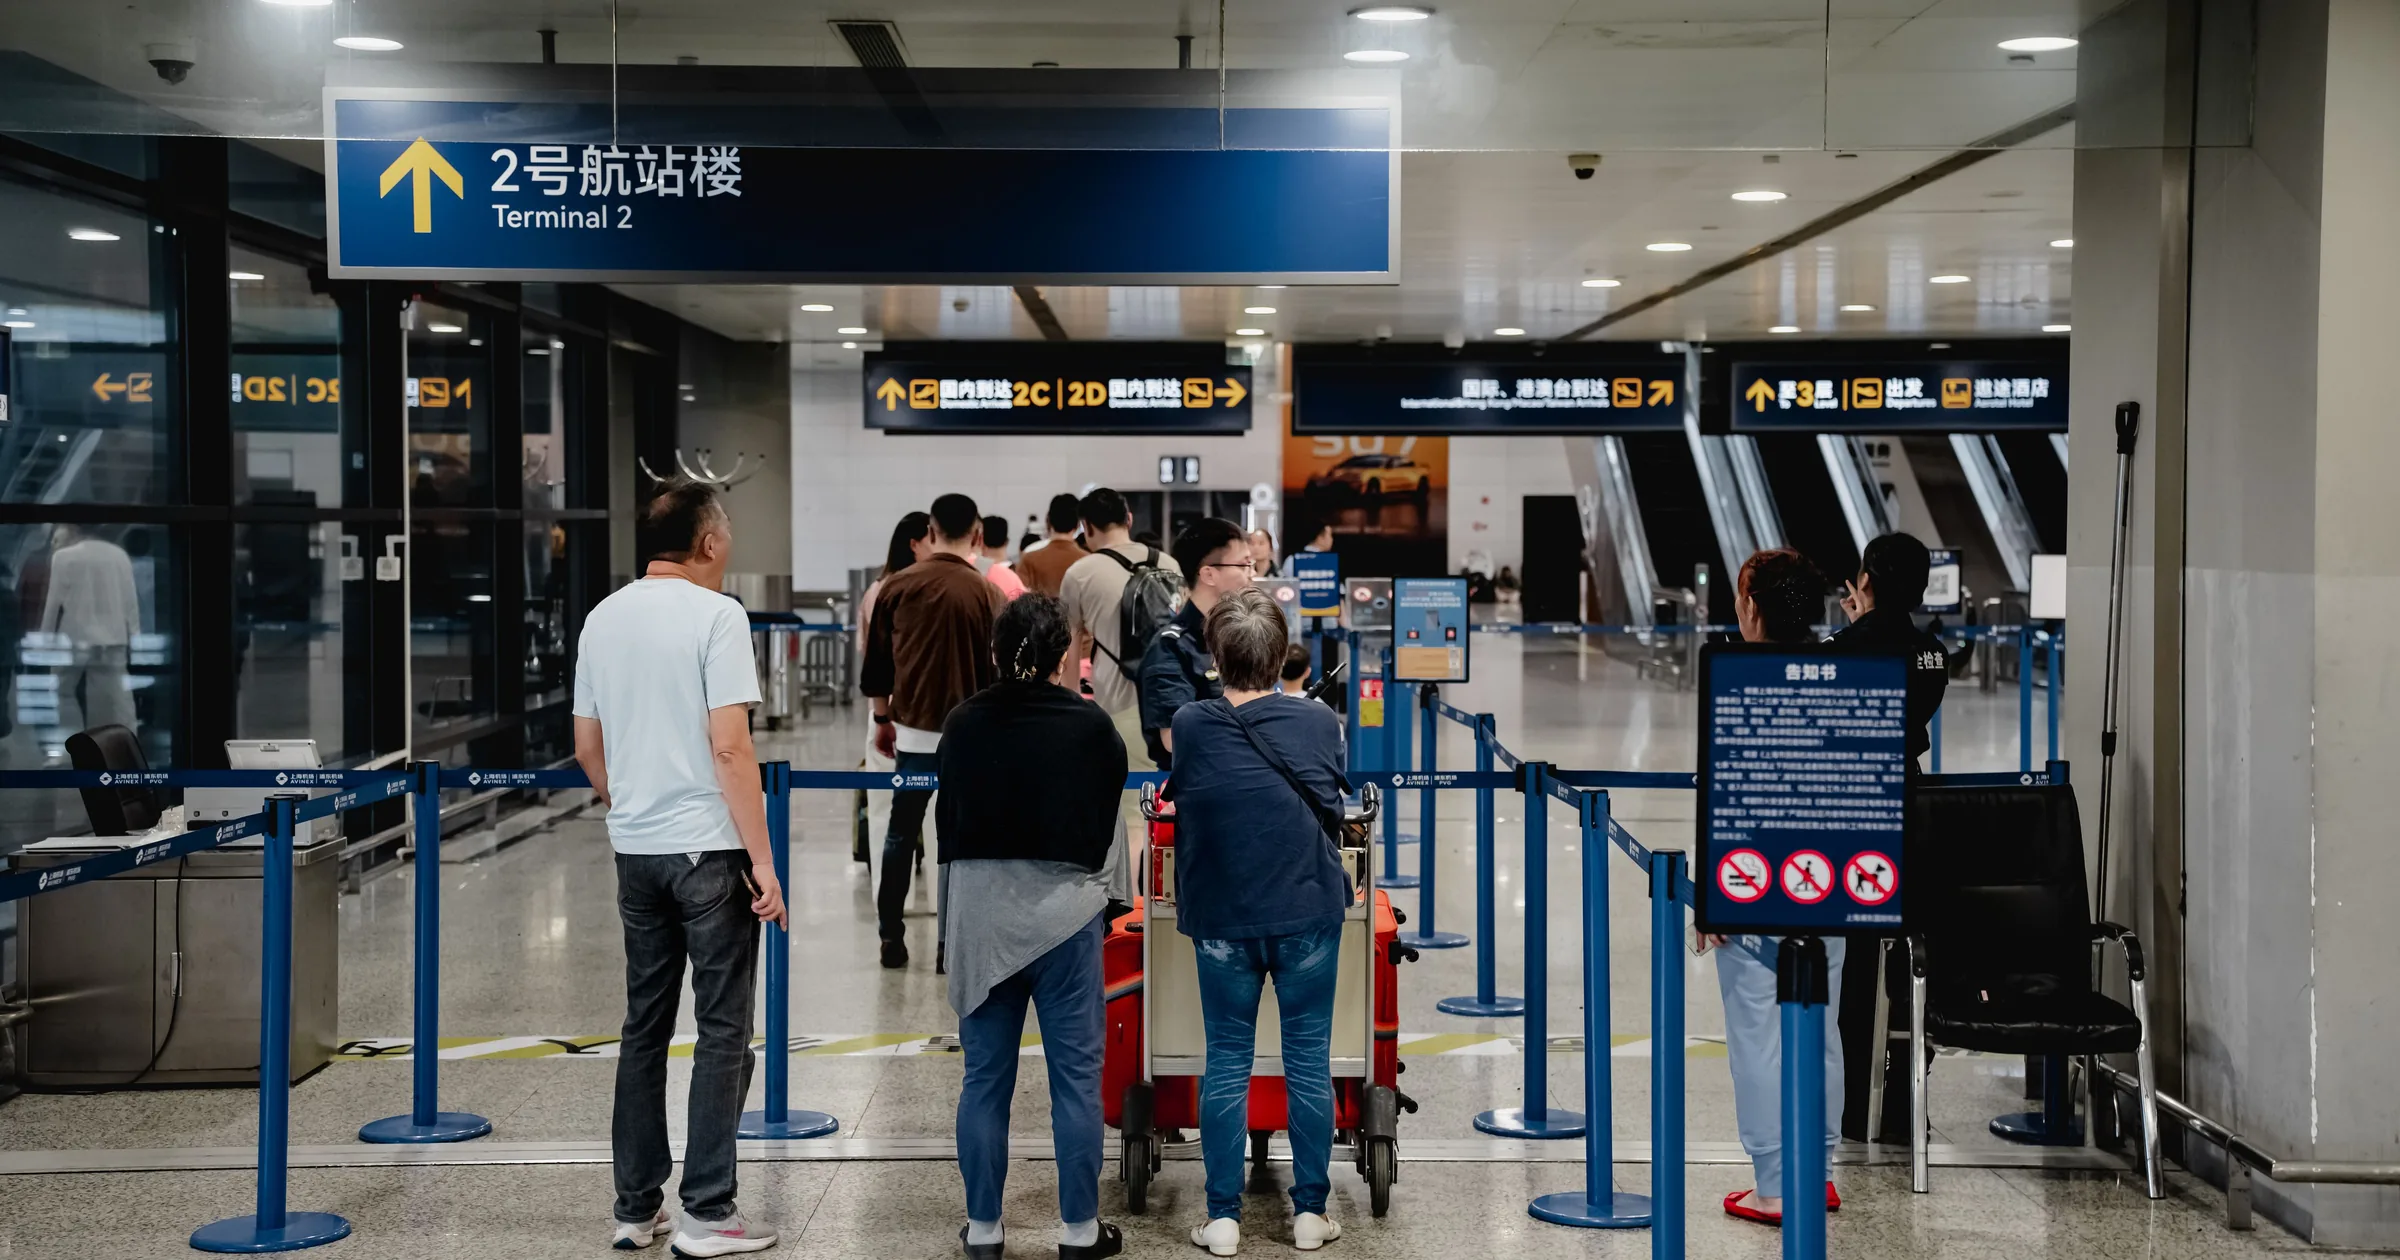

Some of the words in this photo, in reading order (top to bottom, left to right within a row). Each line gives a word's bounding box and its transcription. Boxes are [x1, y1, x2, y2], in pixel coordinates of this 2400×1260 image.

[491, 145, 742, 197] 2号航站楼
[492, 204, 607, 228] Terminal
[616, 205, 633, 229] 2
[1013, 382, 1050, 406] 2C
[1068, 382, 1107, 406] 2D
[1886, 378, 1923, 397] 出发
[1785, 663, 1837, 681] 告知书
